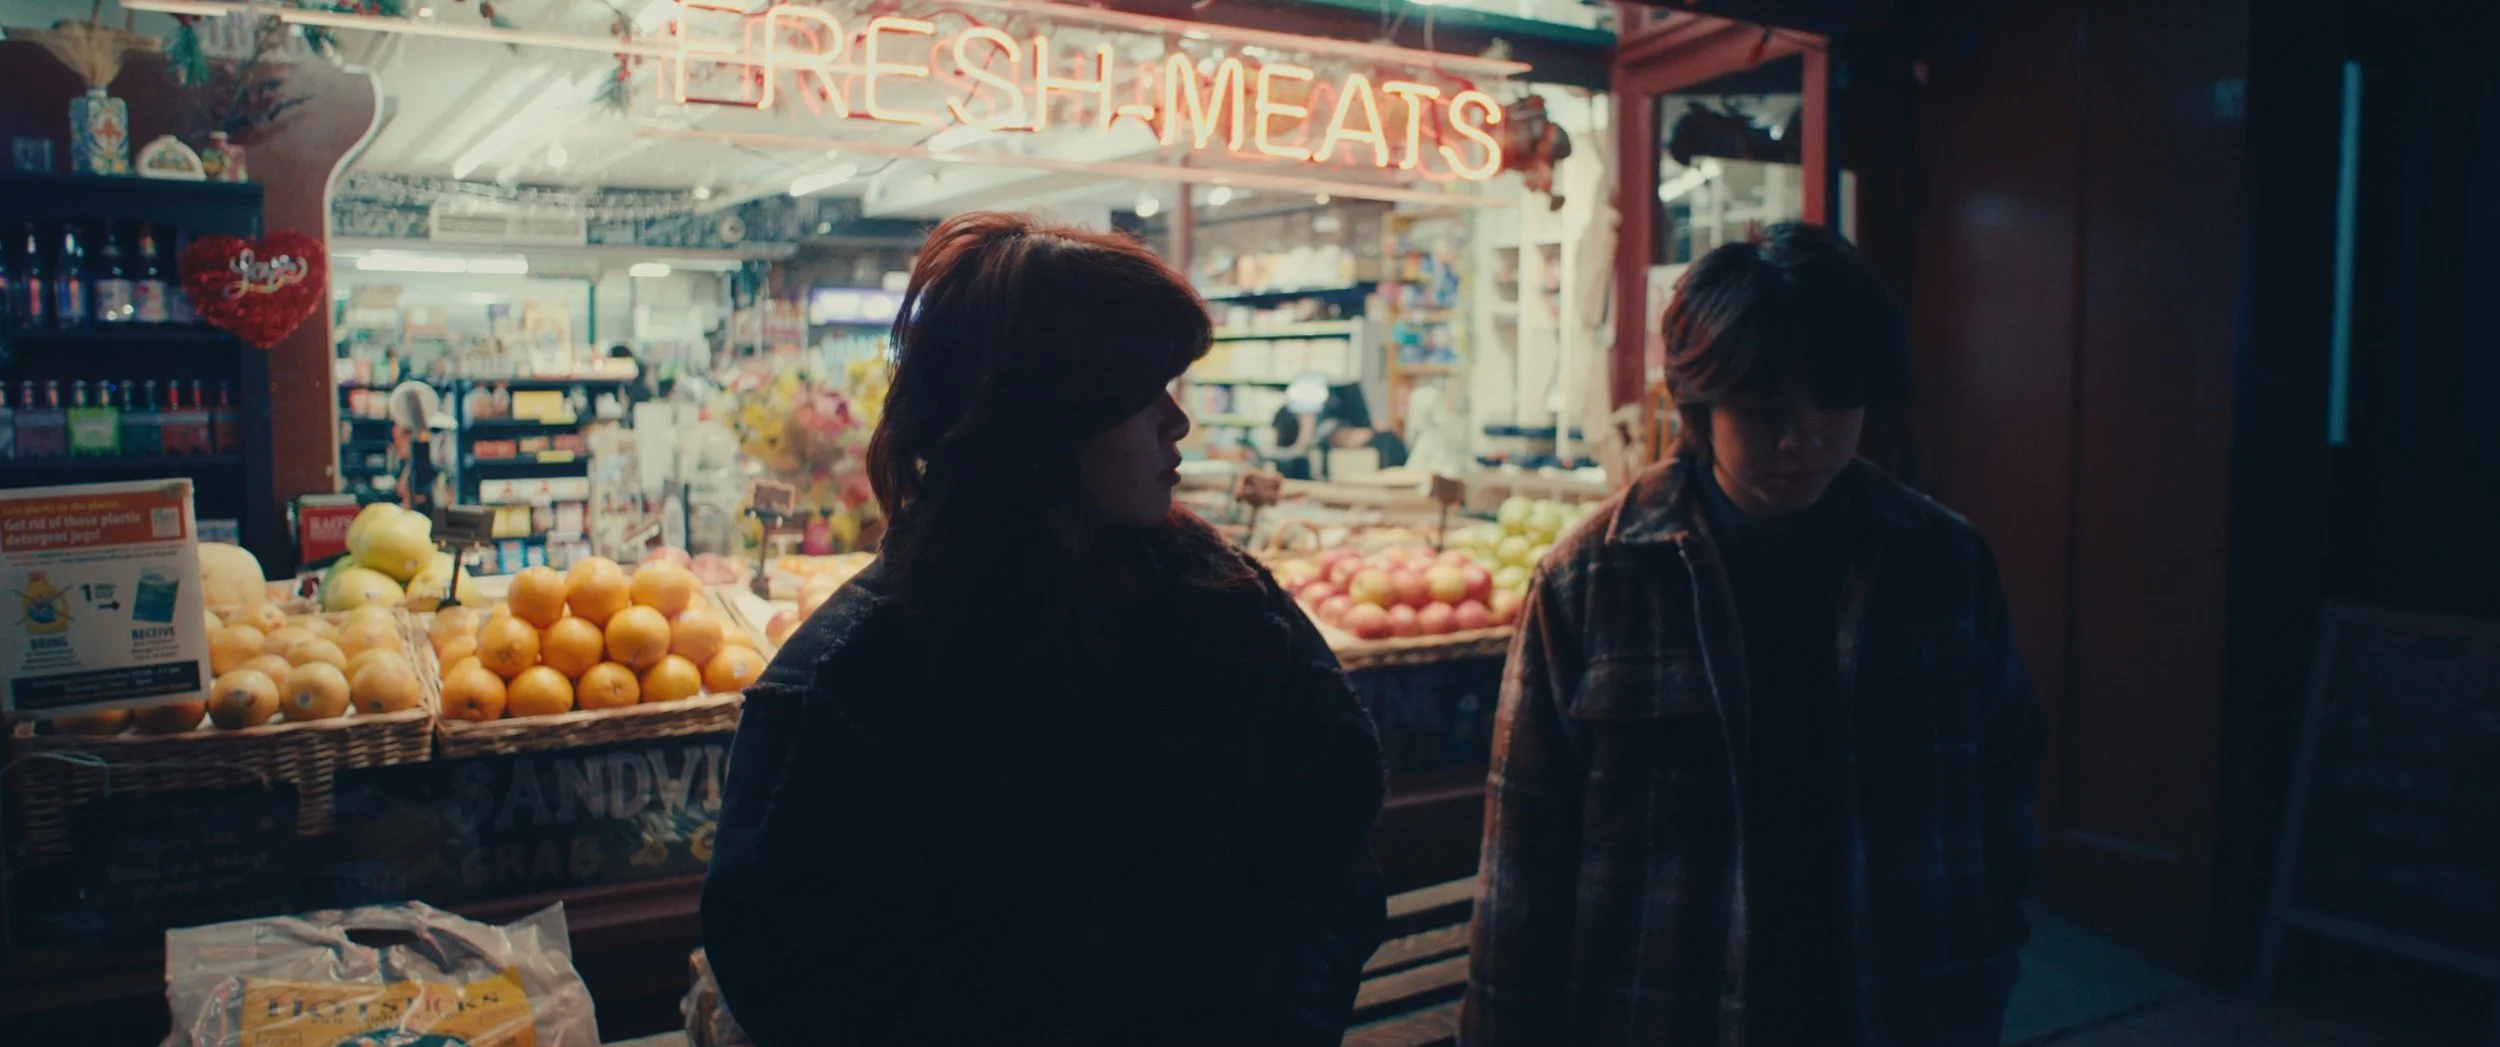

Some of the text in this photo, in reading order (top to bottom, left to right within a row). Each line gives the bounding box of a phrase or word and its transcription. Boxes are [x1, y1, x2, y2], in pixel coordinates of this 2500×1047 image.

[4, 518, 26, 531] Get
[28, 517, 46, 529] rid
[48, 515, 61, 529] of
[101, 510, 140, 528] plastic
[5, 529, 101, 547] detergent jugs!
[81, 583, 92, 602] 1
[131, 626, 175, 640] RECEIVE
[30, 636, 69, 649] BRING
